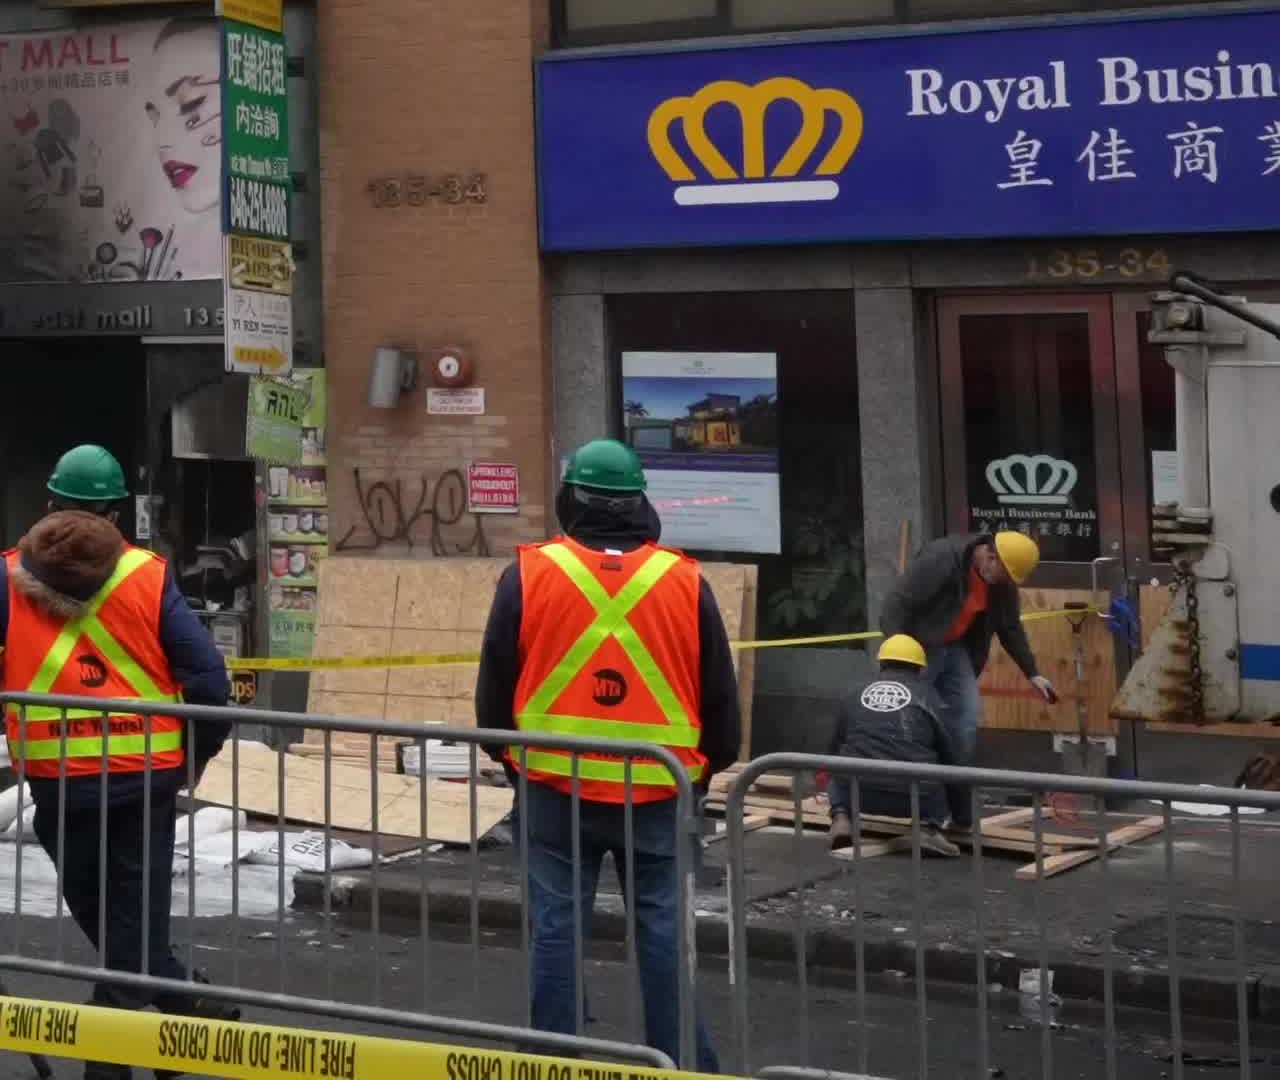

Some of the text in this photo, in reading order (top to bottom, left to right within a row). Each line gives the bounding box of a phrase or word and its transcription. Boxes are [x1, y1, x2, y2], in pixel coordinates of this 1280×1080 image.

[21, 34, 130, 73] MALL
[906, 49, 1280, 124] Royal Busin
[97, 304, 151, 328] mall
[972, 507, 1097, 520] Royal Business Bank
[44, 1007, 79, 1046] FIRE
[158, 1020, 209, 1061] CROSS
[212, 1024, 244, 1065] NOT
[248, 1028, 272, 1069] DO
[320, 1037, 357, 1080] FIRE
